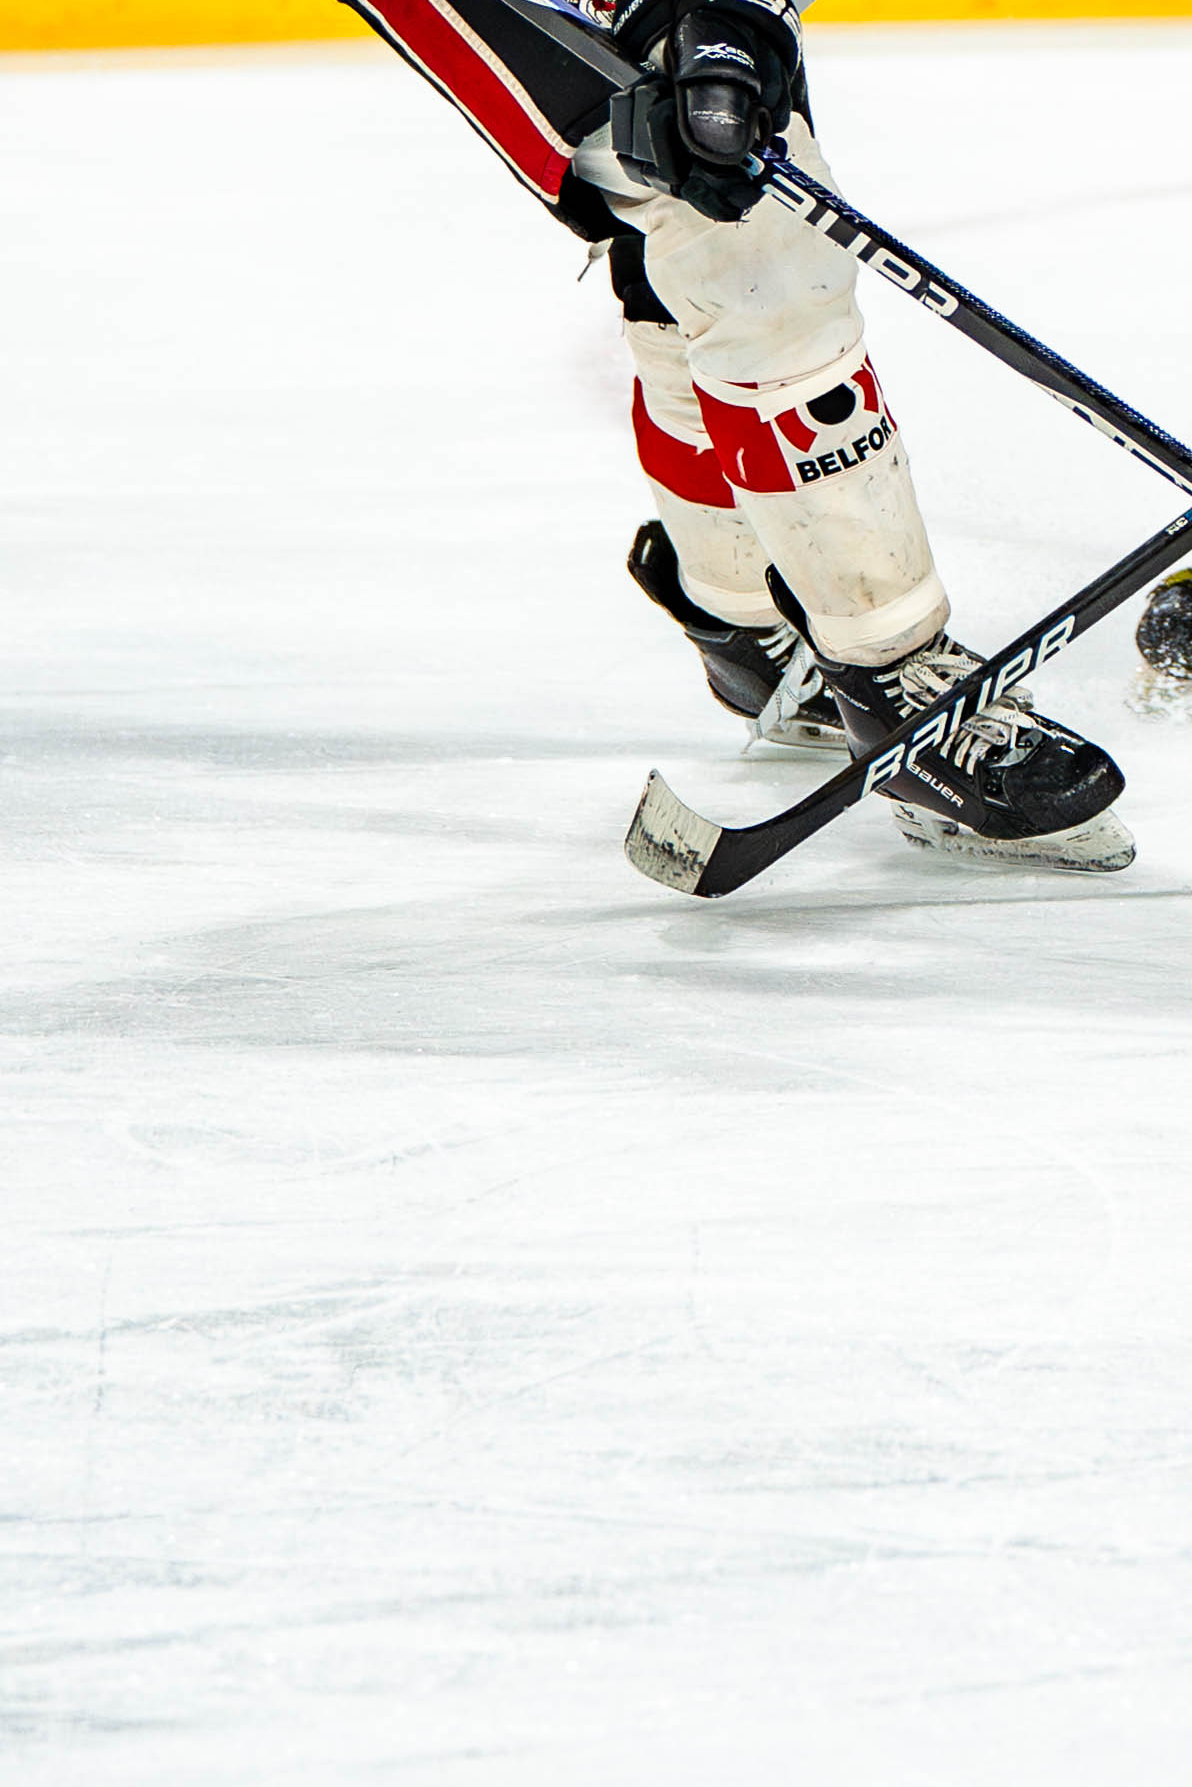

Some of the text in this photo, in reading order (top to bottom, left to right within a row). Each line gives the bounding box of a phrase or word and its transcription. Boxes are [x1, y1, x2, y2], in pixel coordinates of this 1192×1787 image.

[744, 151, 960, 318] AUER
[796, 415, 892, 485] BELFOR
[906, 763, 964, 809] BAUER
